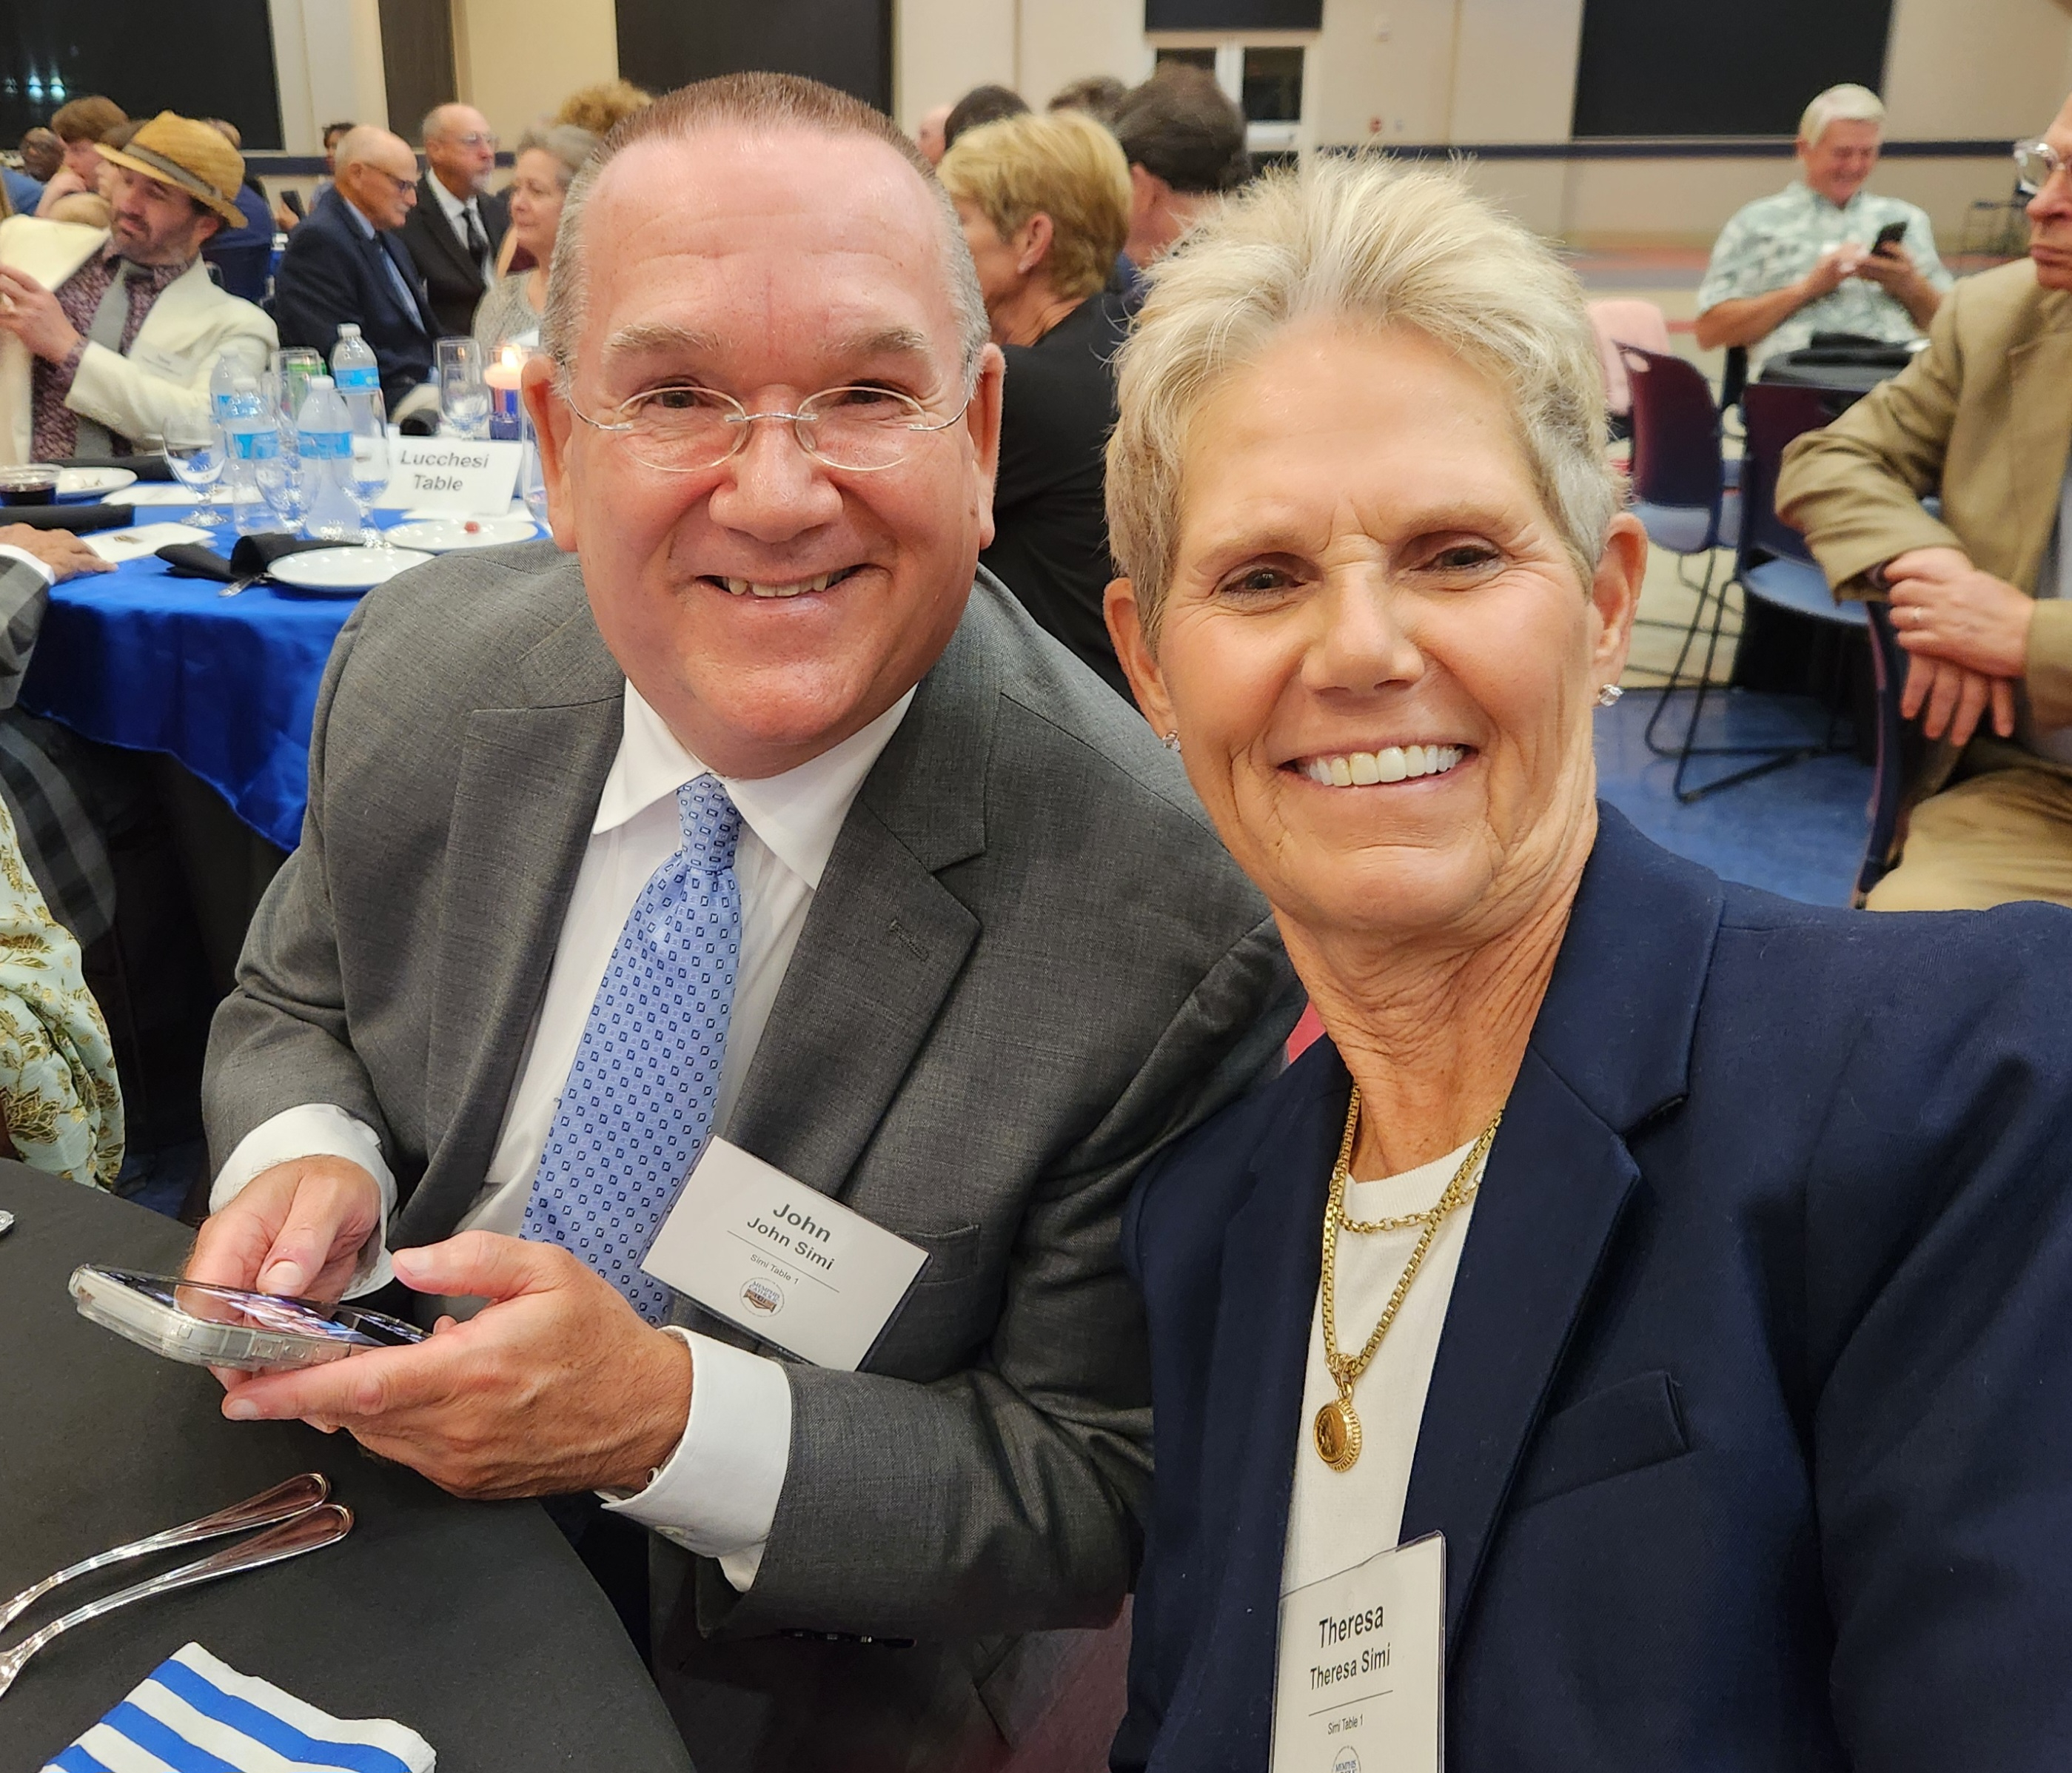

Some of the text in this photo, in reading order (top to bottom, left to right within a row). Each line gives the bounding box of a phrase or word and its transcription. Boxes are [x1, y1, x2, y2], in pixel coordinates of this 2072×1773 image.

[400, 451, 489, 468] Lucchesi
[414, 474, 463, 491] Table
[773, 1204, 831, 1243] John
[747, 1218, 834, 1270] John Simi
[750, 1254, 770, 1268] Simi
[770, 1264, 791, 1281] Table
[1318, 1606, 1384, 1649] Theresa
[1310, 1642, 1391, 1690] Theresa Simi
[1327, 1714, 1363, 1735] Simi Table 1
